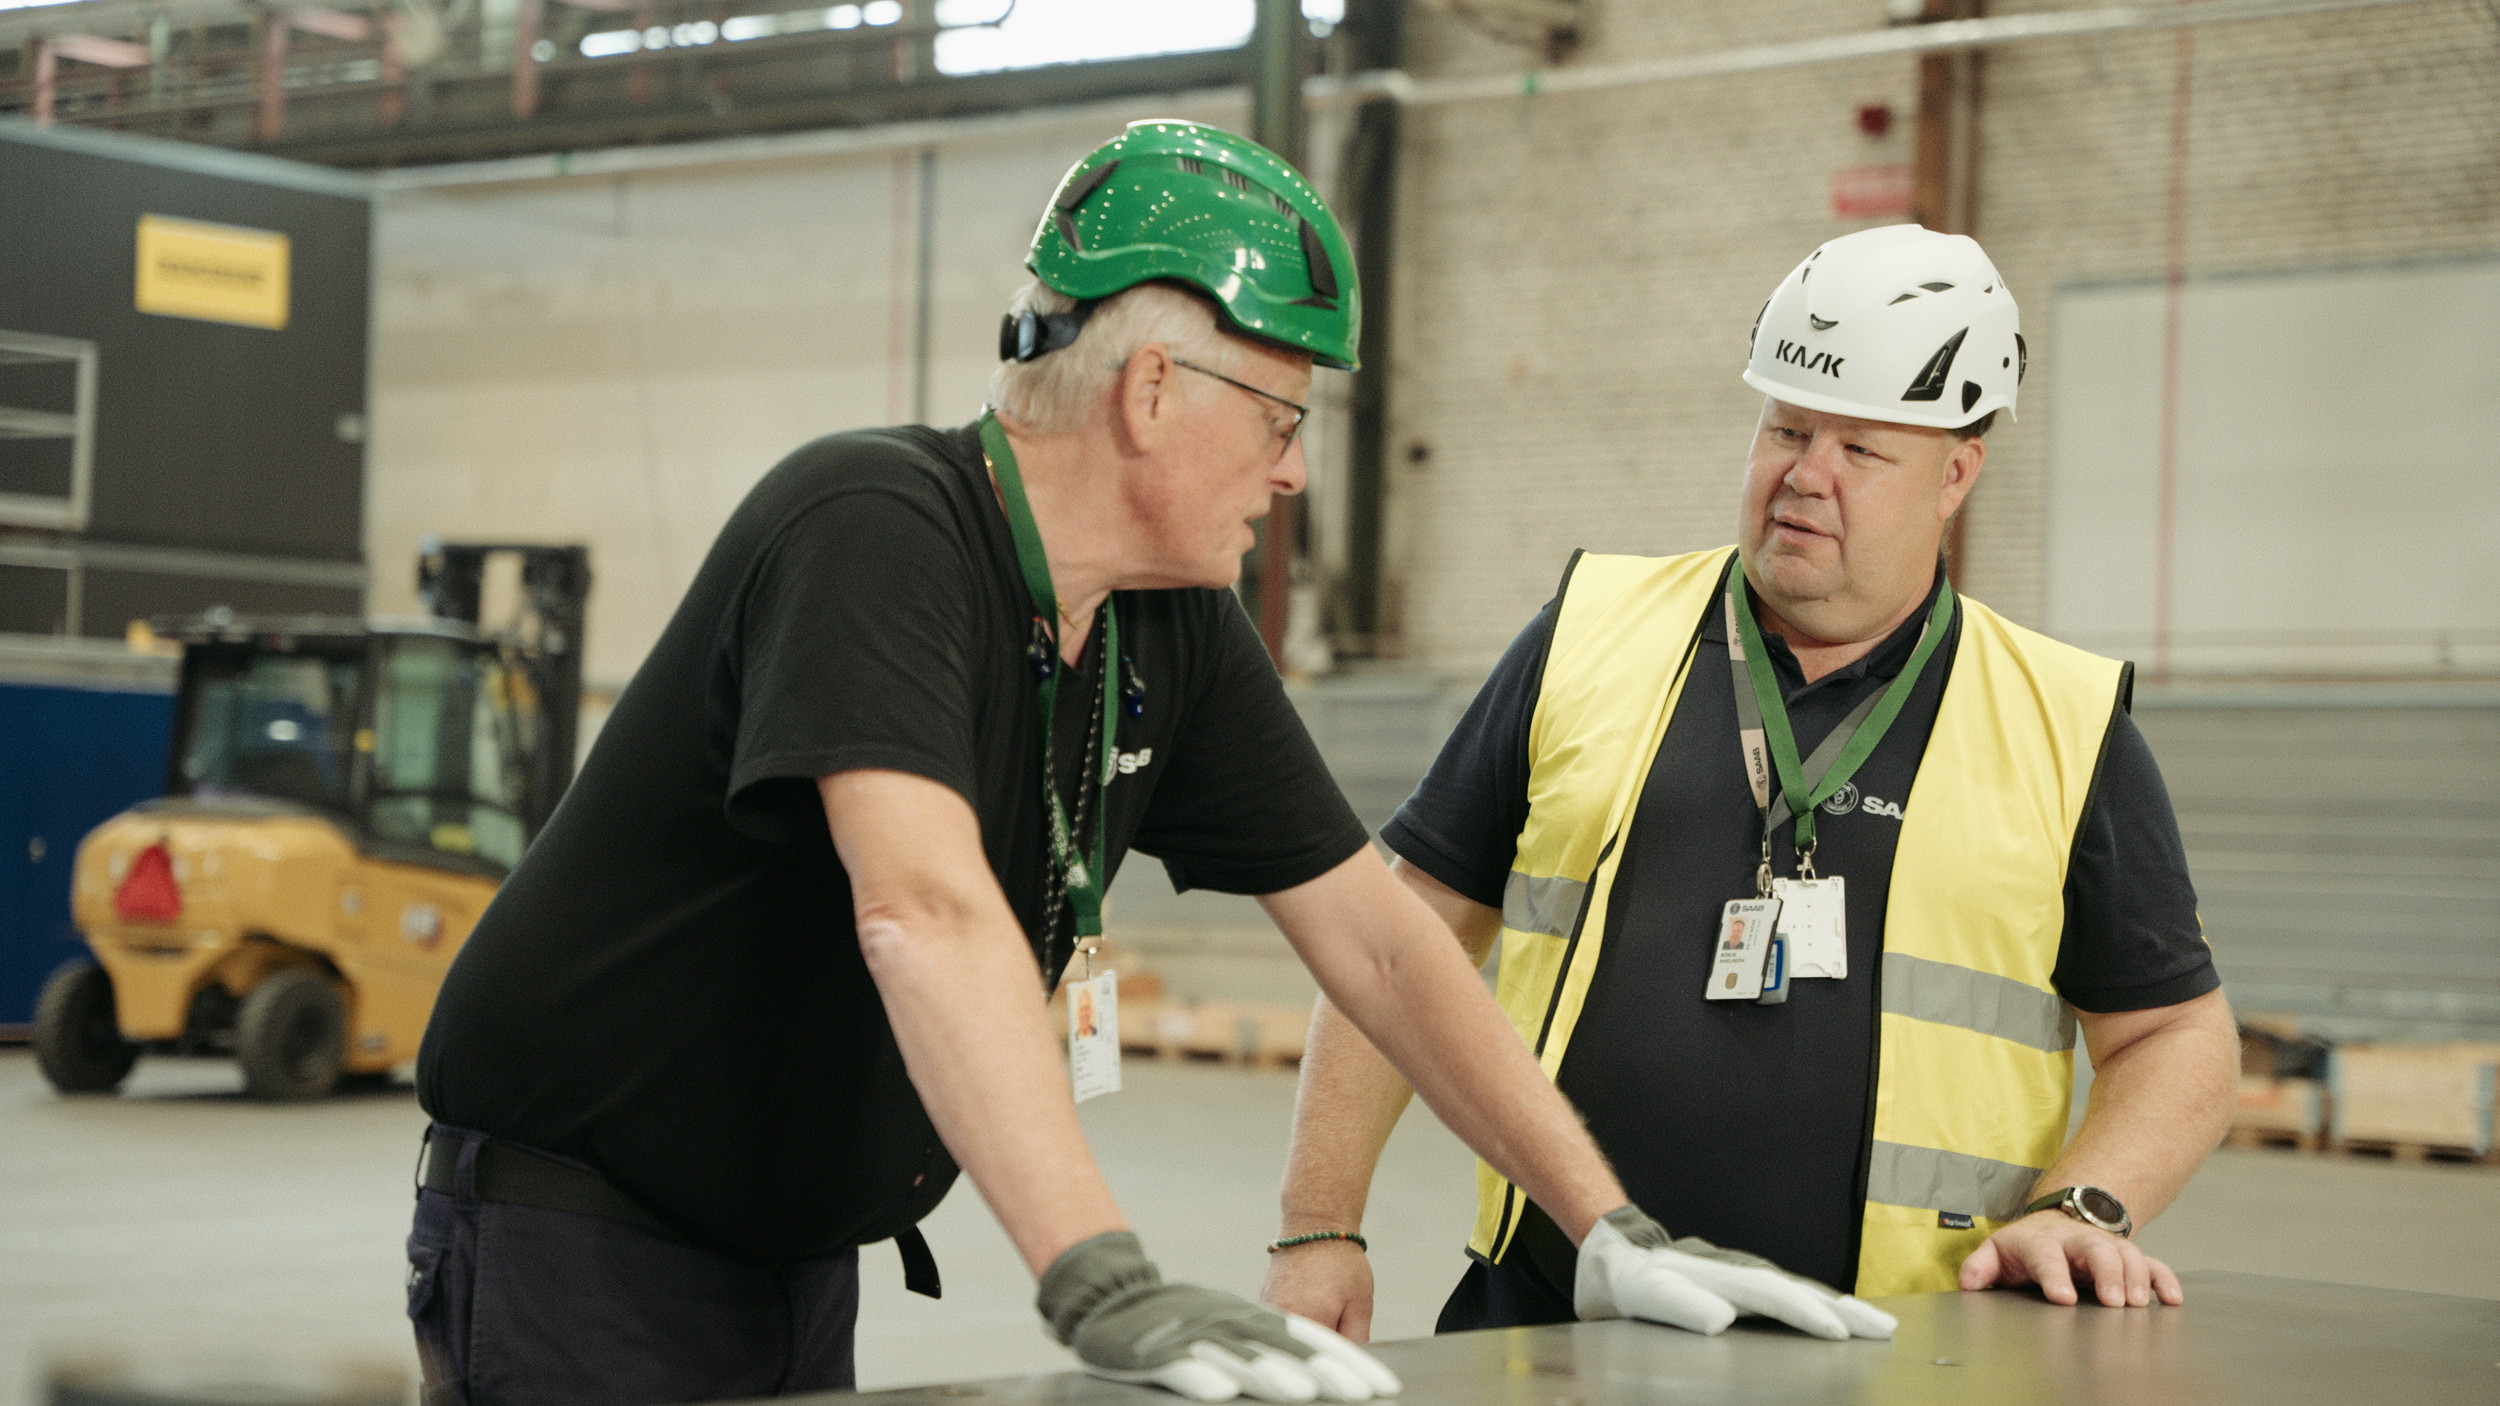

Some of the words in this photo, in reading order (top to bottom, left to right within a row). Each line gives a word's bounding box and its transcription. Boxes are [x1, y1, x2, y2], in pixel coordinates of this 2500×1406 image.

[1775, 339, 1845, 378] KASK
[1753, 747, 1763, 774] SAAB
[1862, 795, 1906, 820] SA
[1742, 904, 1764, 912] SAAB
